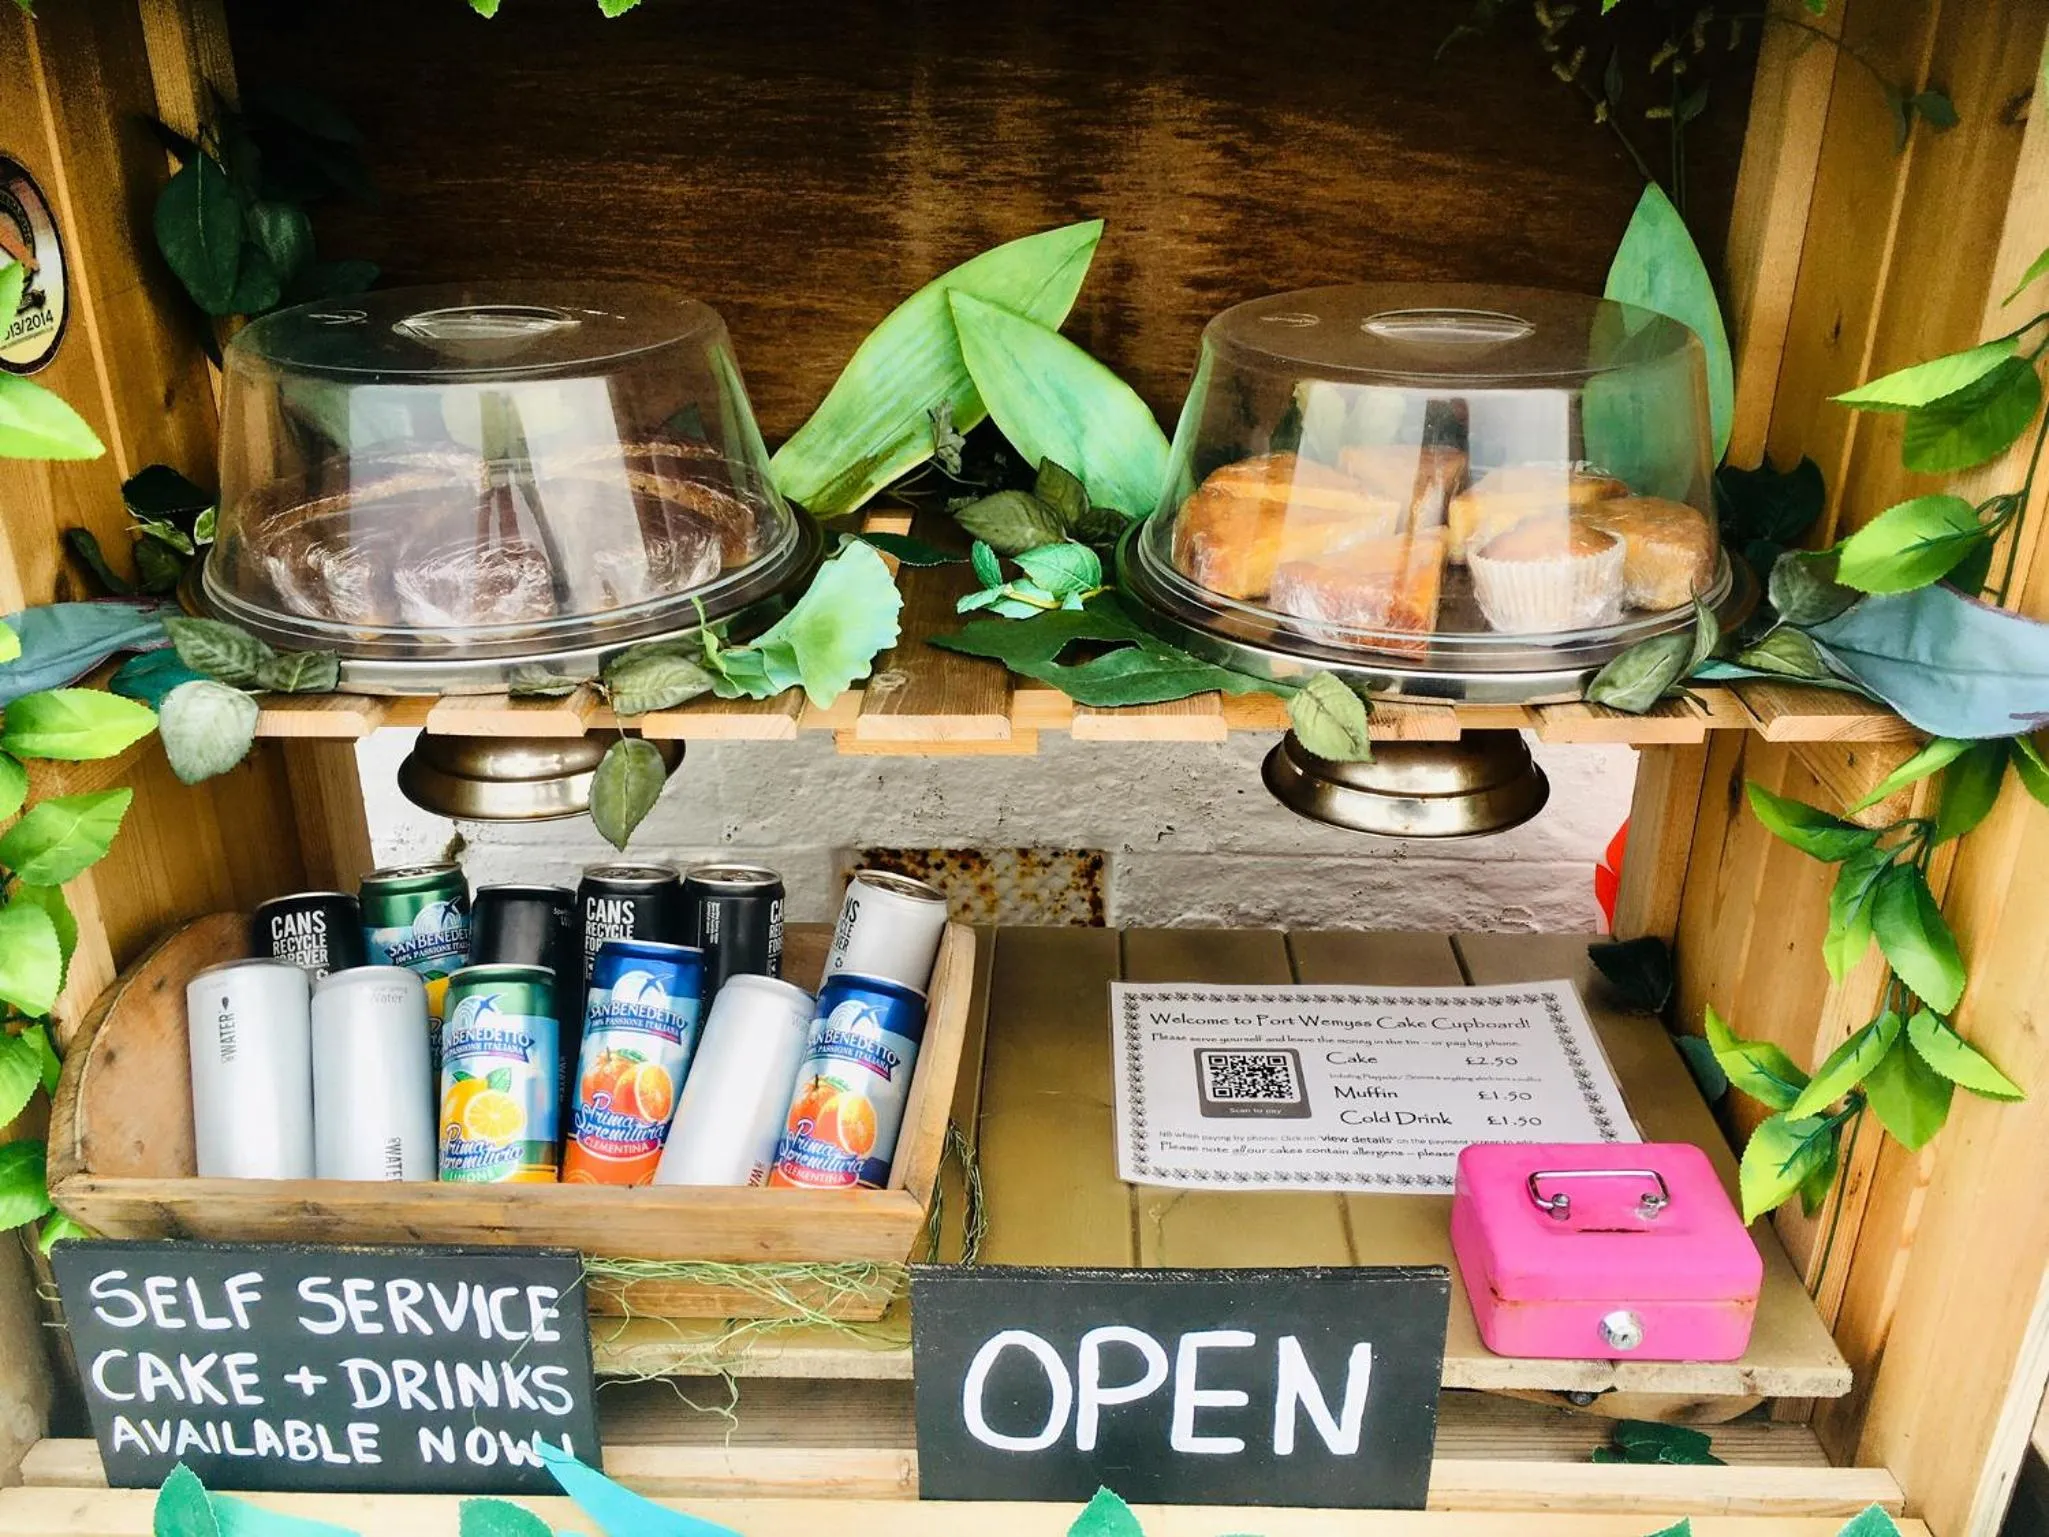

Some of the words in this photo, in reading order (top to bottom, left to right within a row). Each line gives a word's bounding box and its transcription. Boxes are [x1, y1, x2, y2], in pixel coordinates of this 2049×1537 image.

[587, 897, 635, 924] CANS
[272, 910, 326, 940] CANS
[586, 921, 634, 940] RECYCLE
[273, 933, 327, 956] RECYCLE
[1150, 1013, 1229, 1025] Welcome
[1234, 1017, 1252, 1025] to
[1257, 1014, 1295, 1026] Port
[1298, 1015, 1372, 1030] Wemyss
[1376, 1016, 1427, 1029] Cake
[1431, 1017, 1531, 1032] Cupboard!
[219, 1013, 236, 1056] WATER
[1152, 1033, 1186, 1042] Please
[1266, 1035, 1285, 1043] and
[1318, 1036, 1335, 1044] the
[1446, 1040, 1467, 1049] pay
[1469, 1039, 1483, 1049] by
[1326, 1052, 1378, 1065] Cake
[1465, 1057, 1518, 1066] £2.50
[1334, 1086, 1398, 1099] Muffin
[1478, 1091, 1532, 1101] £1.50
[1340, 1110, 1390, 1125] Cold
[1395, 1111, 1452, 1125] Drink
[1487, 1116, 1542, 1126] £1.50
[584, 1136, 649, 1153] CLEMENTINA
[1160, 1141, 1198, 1152] Please
[1269, 1145, 1303, 1154] cakes
[1306, 1147, 1349, 1155] contain
[1417, 1150, 1456, 1159] please
[385, 1144, 403, 1181] WATE
[784, 1163, 847, 1182] CLEMENTINA
[89, 1270, 264, 1331] SELF
[297, 1276, 561, 1342] SERVICE
[91, 1349, 265, 1406] CAKE
[284, 1366, 328, 1396] +
[339, 1358, 574, 1417] DRINKS
[962, 1325, 1372, 1456] OPEN
[112, 1415, 382, 1465] AVAILABLE
